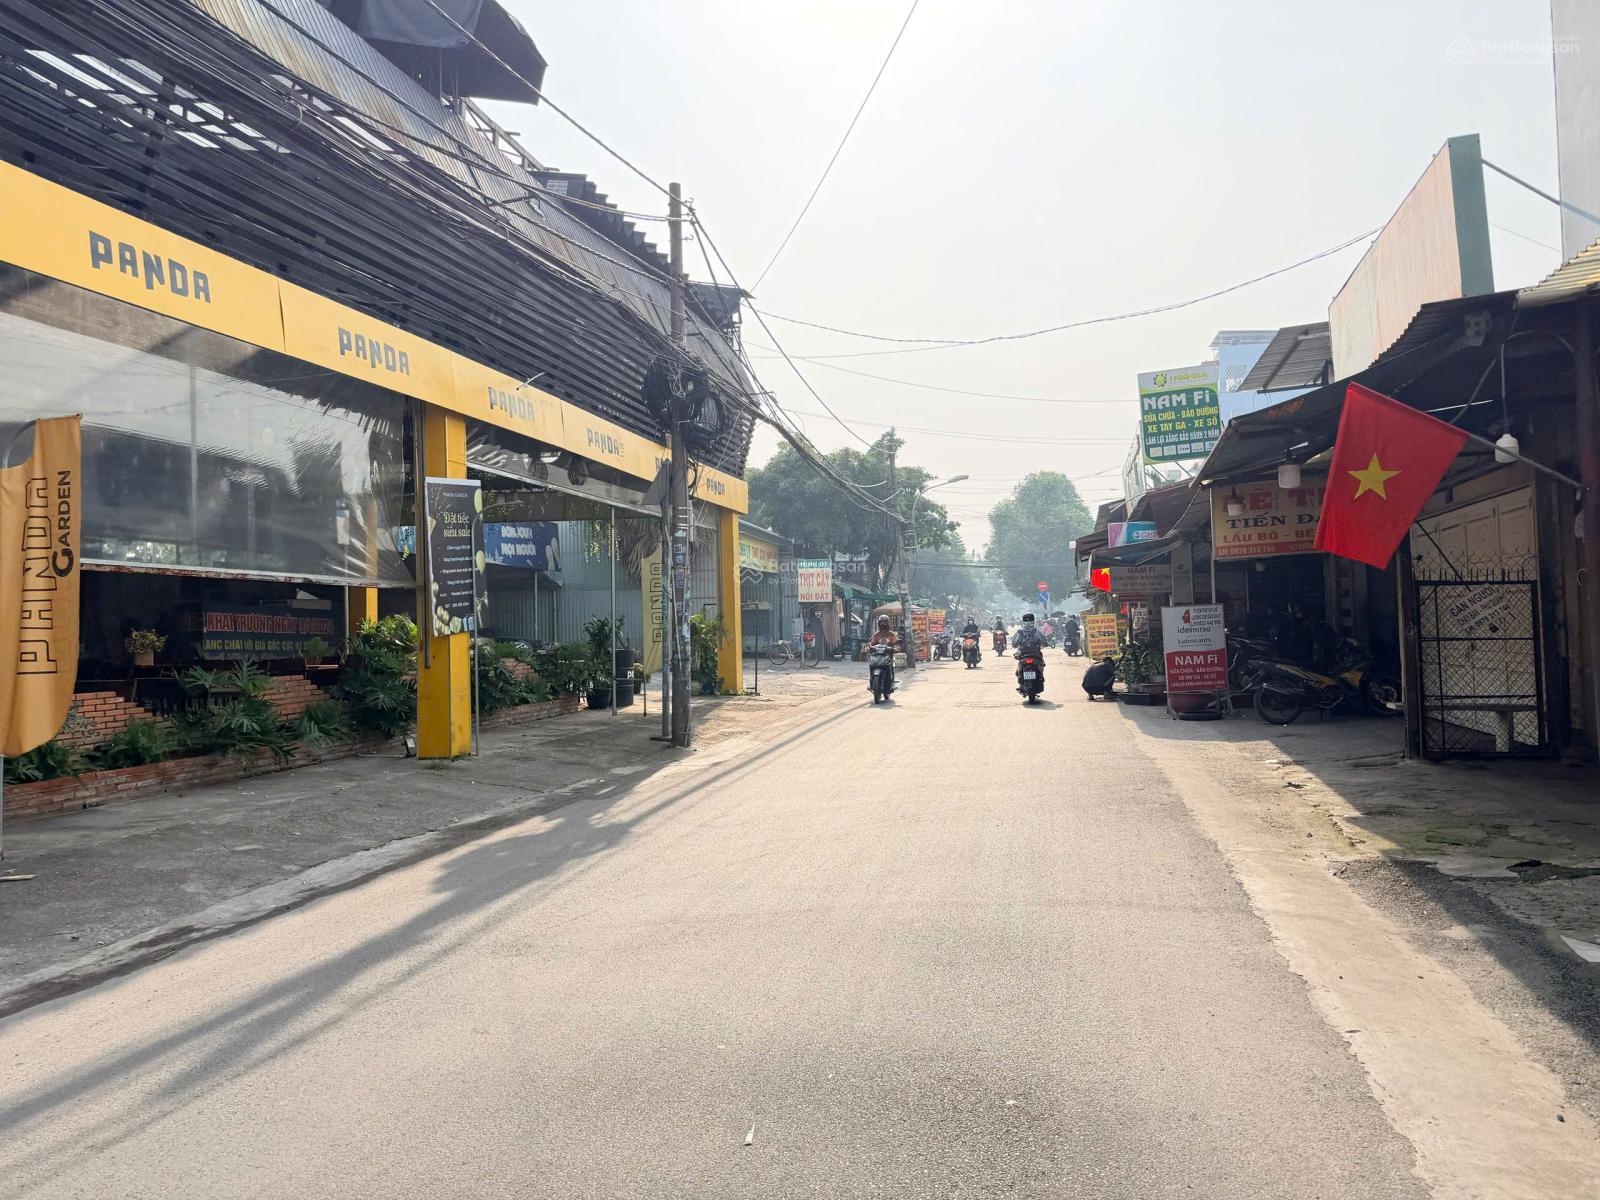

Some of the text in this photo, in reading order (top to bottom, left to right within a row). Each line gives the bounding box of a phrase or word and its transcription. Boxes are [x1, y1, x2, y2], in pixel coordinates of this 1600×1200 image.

[89, 230, 211, 304] PANDA
[337, 326, 411, 376] PANDA
[488, 386, 536, 422] PANDA
[1143, 389, 1210, 410] NAM Fi
[1144, 411, 1157, 423] SỬA
[1158, 410, 1176, 421] CHỮA
[1181, 407, 1195, 418] BẢO
[1147, 424, 1158, 434] XE
[1160, 423, 1173, 432] TAY
[1175, 420, 1186, 430] GA
[1193, 419, 1205, 428] XE
[1206, 415, 1218, 426] SỐ
[587, 427, 620, 456] PANDA
[706, 477, 726, 496] PANDA
[52, 470, 74, 577] GARDEN
[458, 525, 471, 537] sale
[1226, 512, 1288, 529] TIẾN
[16, 477, 57, 675] PANDA
[1174, 654, 1218, 666] NAM Fi
